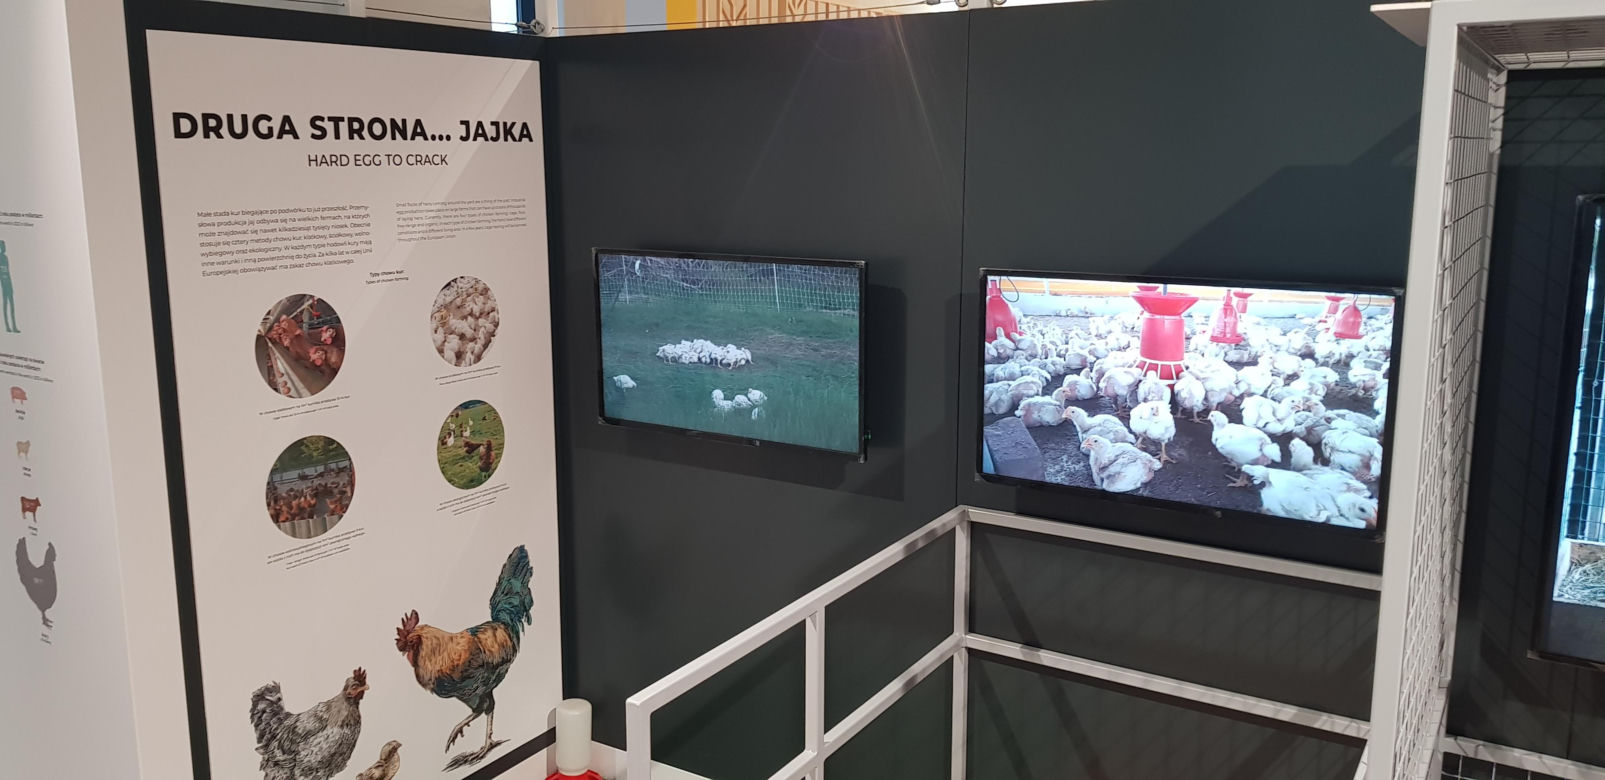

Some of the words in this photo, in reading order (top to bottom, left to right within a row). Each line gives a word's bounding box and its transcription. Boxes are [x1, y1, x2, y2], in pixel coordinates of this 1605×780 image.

[172, 112, 300, 140] DRUGA
[309, 115, 451, 141] STRONA...
[459, 120, 534, 142] JAJKA
[308, 154, 350, 167] HARD
[354, 154, 382, 166] EGG
[385, 154, 403, 166] TO
[406, 154, 448, 166] CRACK
